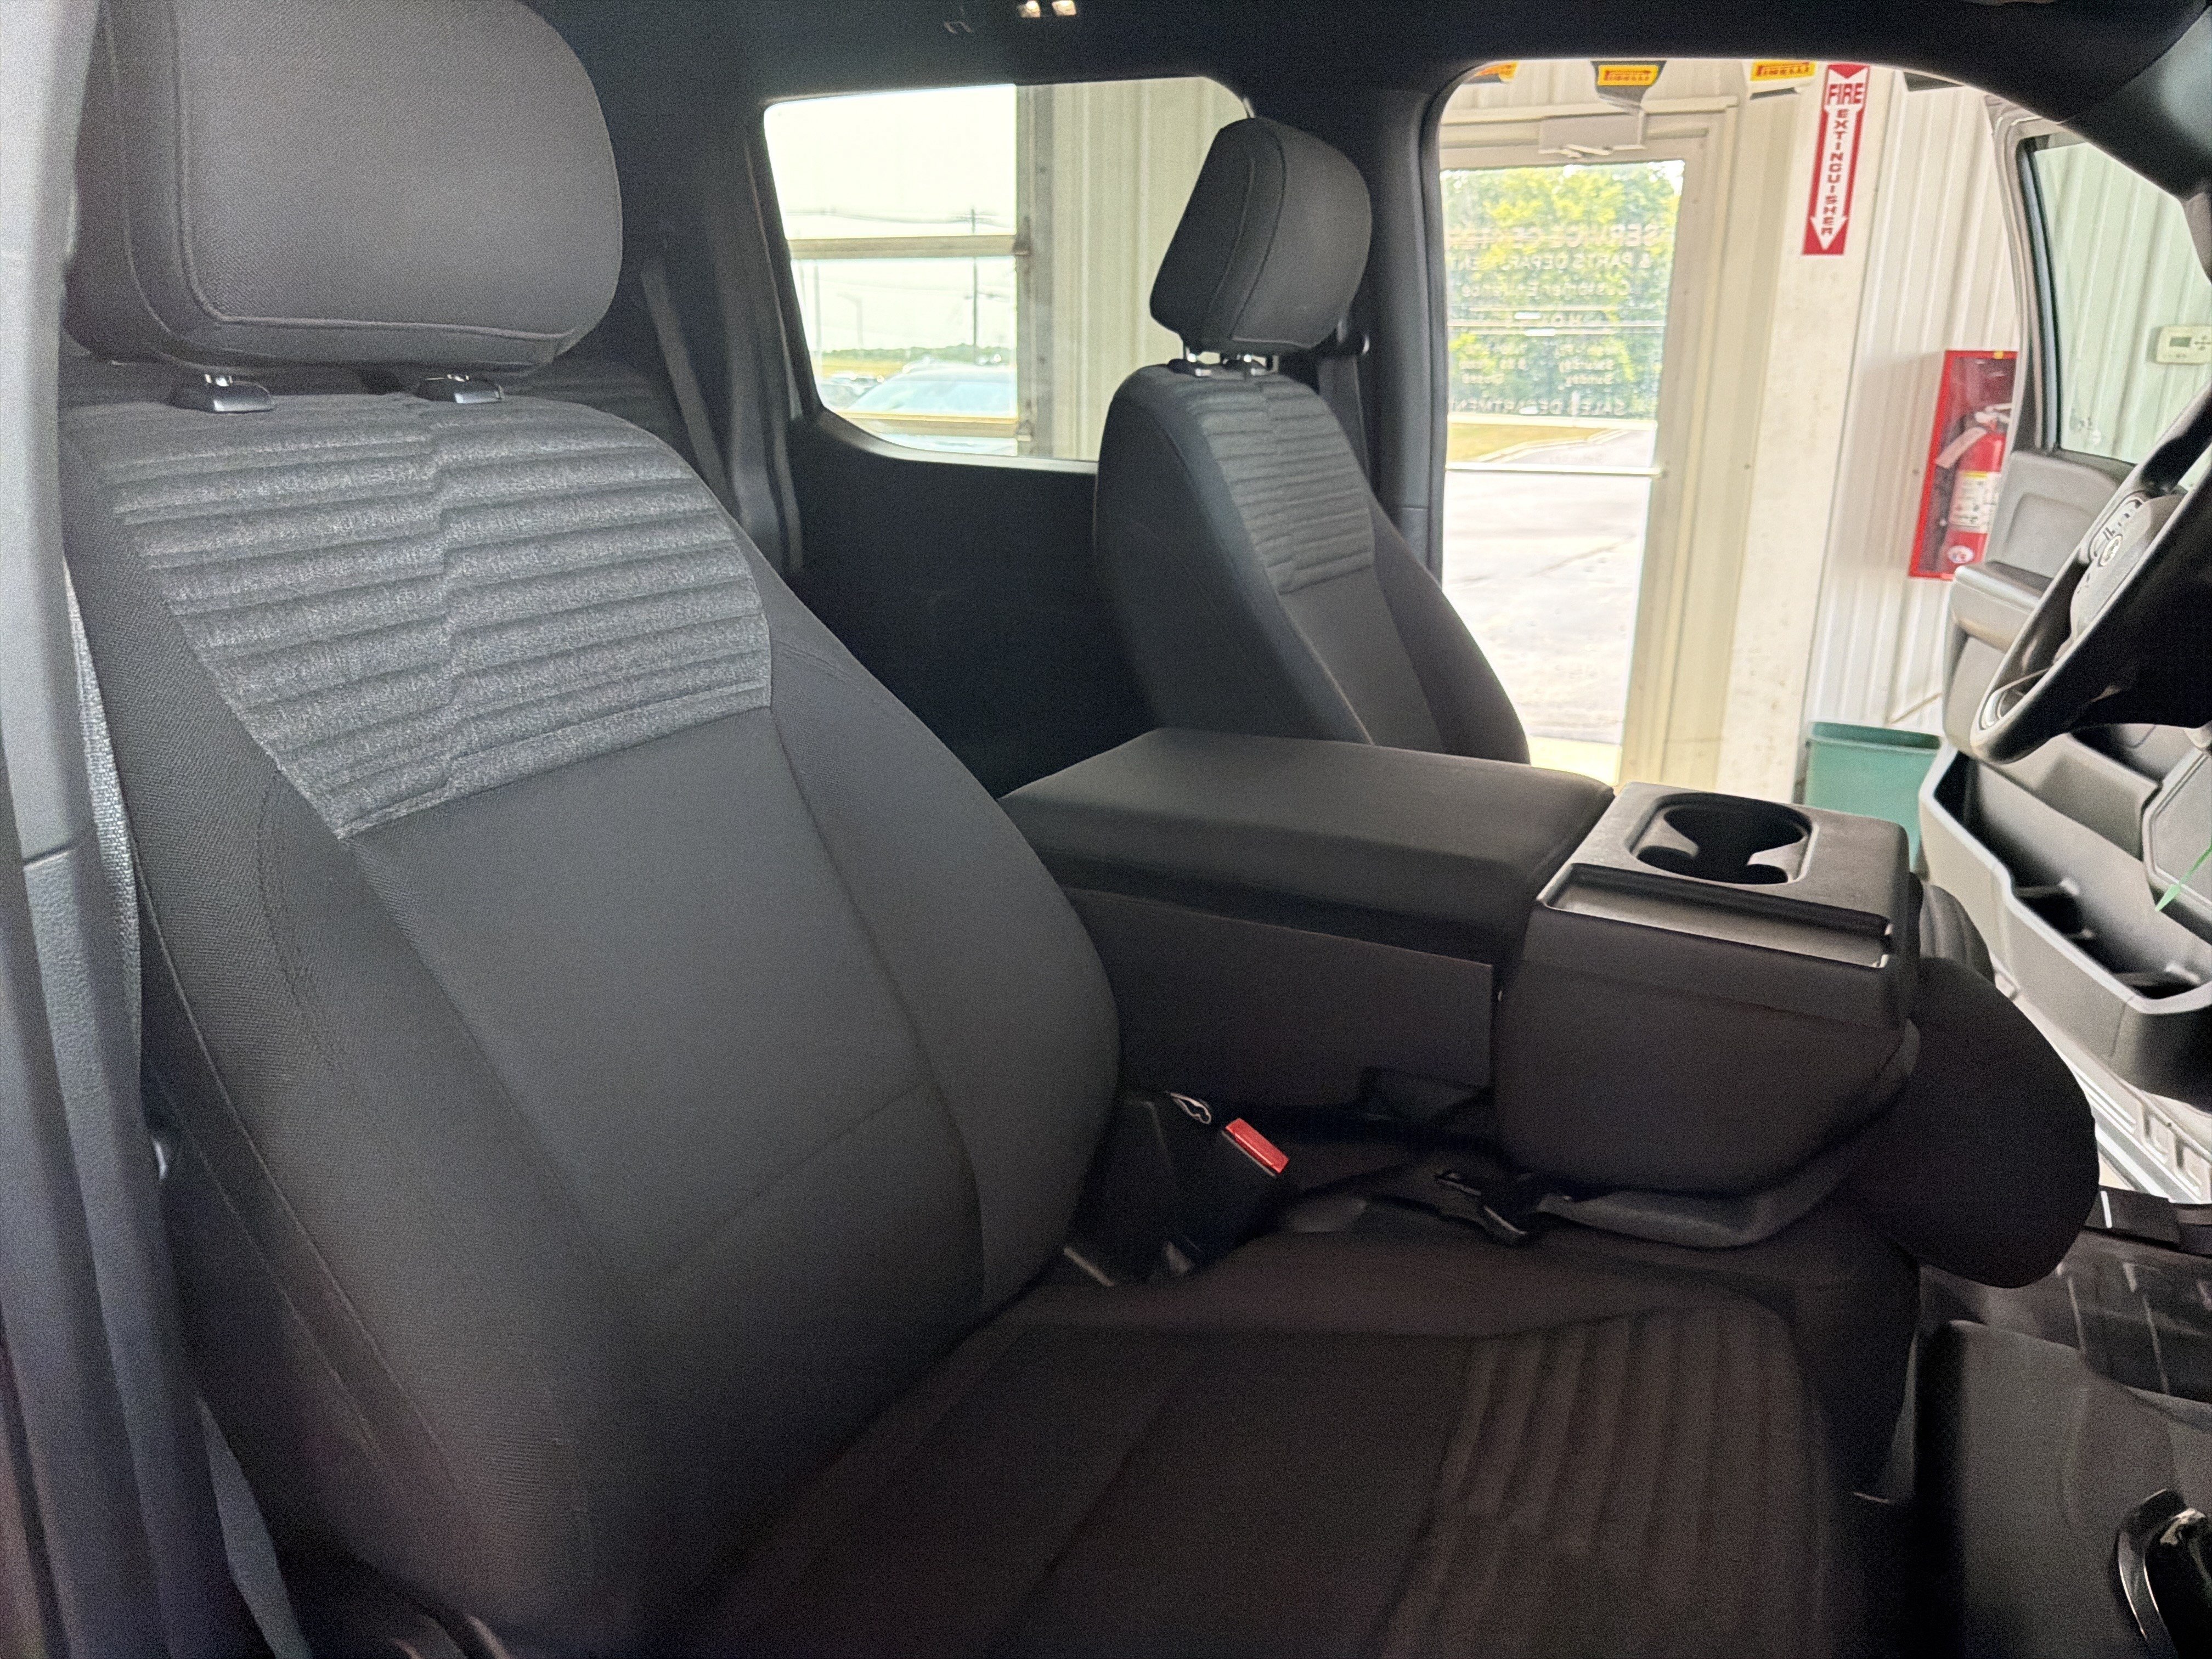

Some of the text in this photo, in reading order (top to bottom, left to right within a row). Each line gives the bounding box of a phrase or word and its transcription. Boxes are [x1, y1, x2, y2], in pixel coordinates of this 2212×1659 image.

[1604, 69, 1651, 82] PIRELLI
[1756, 61, 1810, 77] PIRELLI
[1827, 83, 1864, 105] FIRE
[1821, 109, 1849, 235] EXTINGUISHER
